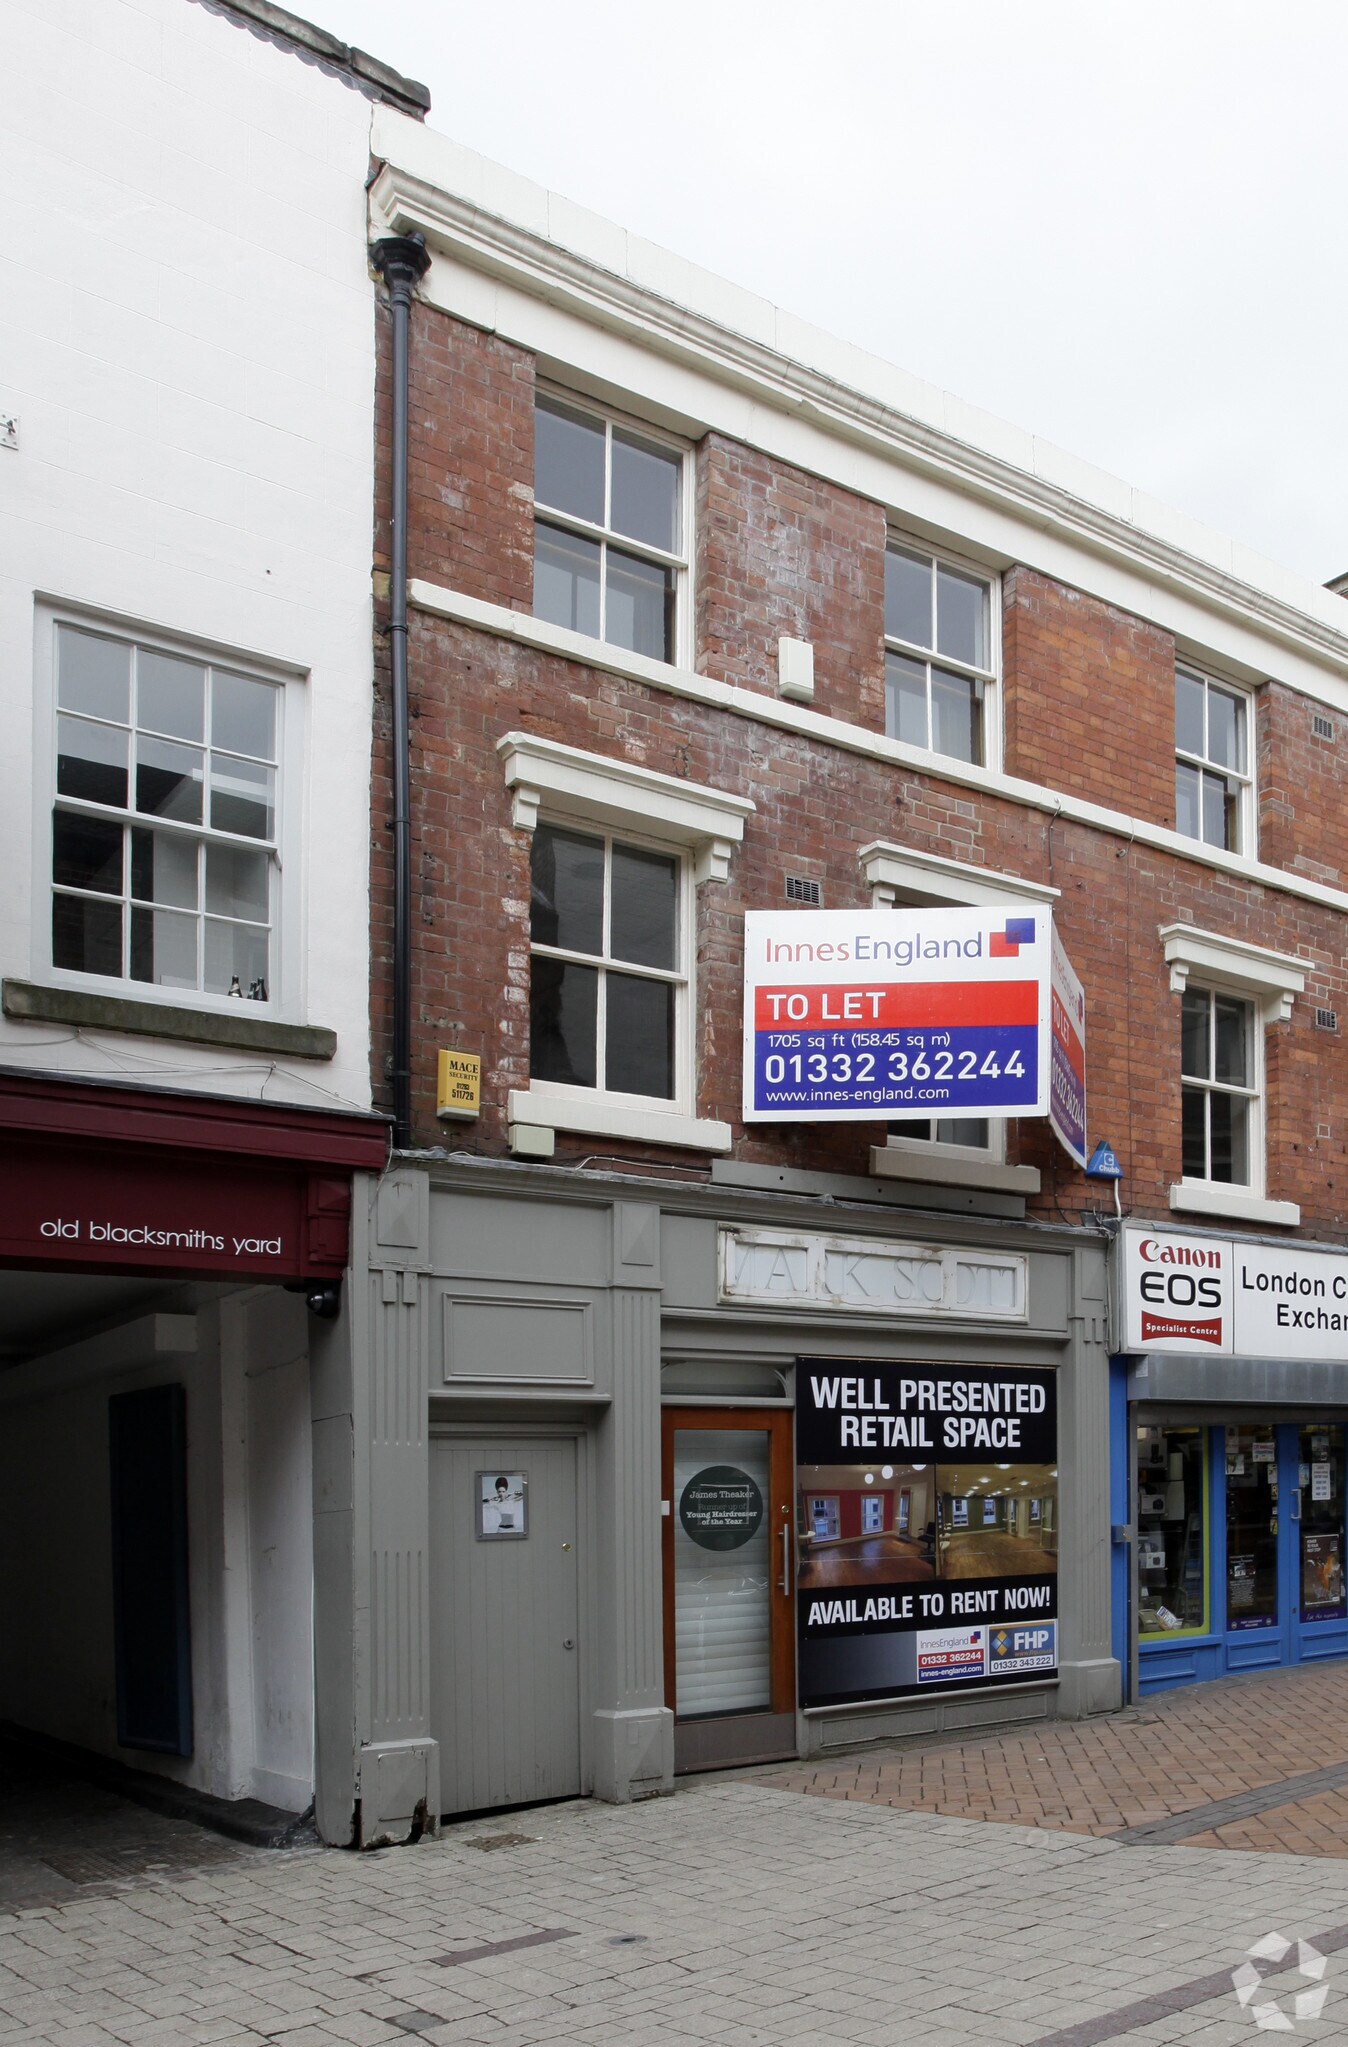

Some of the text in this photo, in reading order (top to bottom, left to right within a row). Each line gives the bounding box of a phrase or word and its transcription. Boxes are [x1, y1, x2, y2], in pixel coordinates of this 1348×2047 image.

[766, 991, 886, 1021] TO LET
[768, 1031, 951, 1050] 1705 sq ft (158.45 sq m)
[449, 1060, 479, 1074] MACE
[765, 1053, 876, 1083] 01332
[888, 1050, 1026, 1081] 362244
[449, 1072, 478, 1081] SECURITY
[452, 1089, 474, 1101] 511726
[766, 1087, 950, 1104] www.innes-england.com
[1099, 1164, 1120, 1174] Chubb
[40, 1218, 281, 1255] old blacksmiths yard
[1139, 1239, 1221, 1269] Canon
[1140, 1271, 1222, 1308] EOS
[1242, 1265, 1325, 1297] London
[1146, 1322, 1218, 1336] Specialist Centre
[810, 1376, 1046, 1413] WELL PRESENTED
[840, 1415, 1021, 1448] RETAIL SPACE
[712, 1510, 757, 1518] Hairdresser
[807, 1586, 1050, 1625] AVAILABLE TO RENT NOW!
[1013, 1630, 1049, 1651] FHP
[921, 1651, 981, 1666] 01332 362244
[993, 1656, 1050, 1670] 01332 343 222
[920, 1665, 982, 1678] innes-england.com
